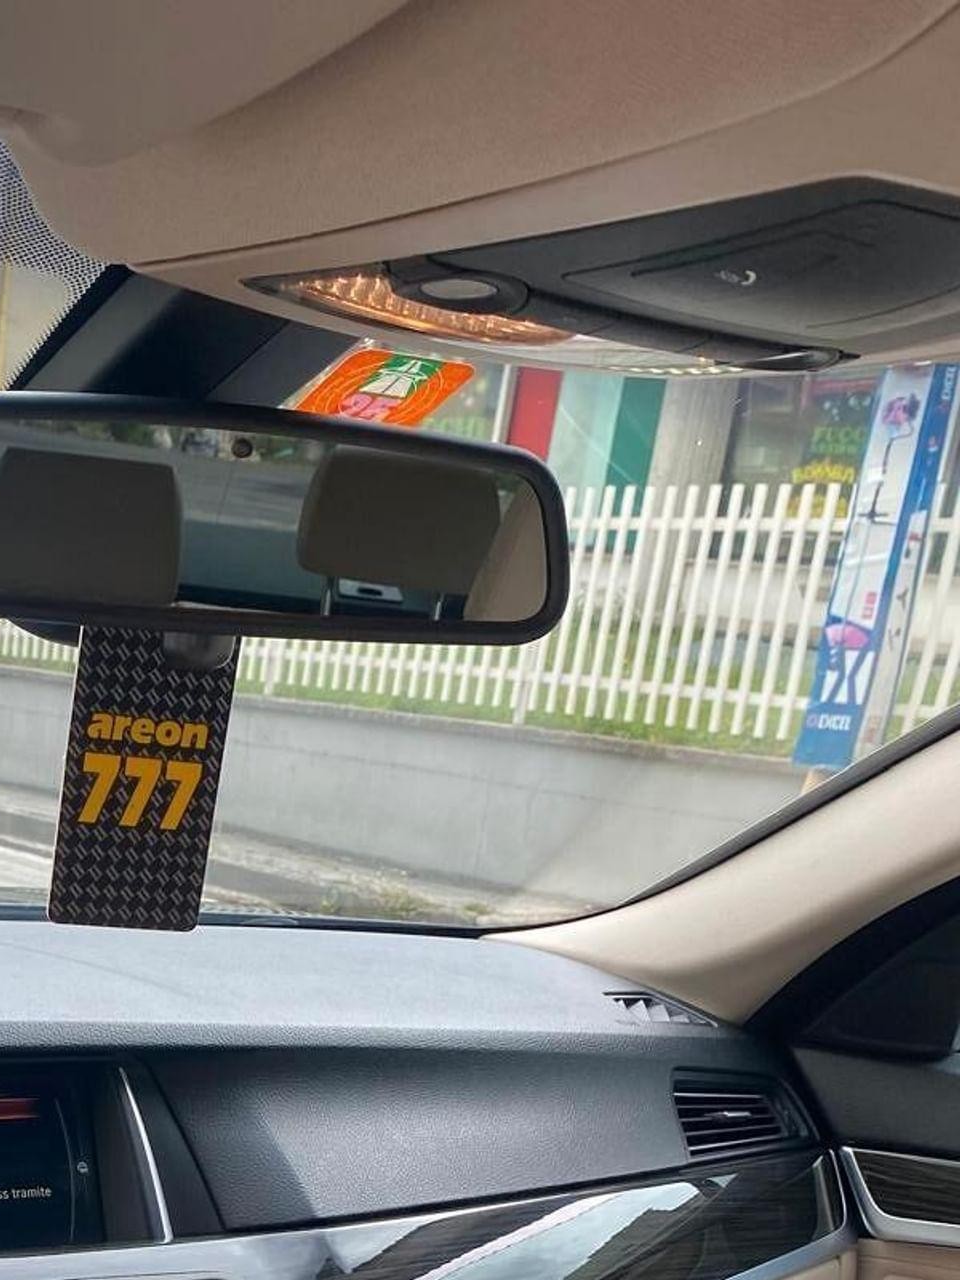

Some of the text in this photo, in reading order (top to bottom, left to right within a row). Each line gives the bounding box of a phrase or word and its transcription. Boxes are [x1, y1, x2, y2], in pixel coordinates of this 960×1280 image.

[86, 711, 210, 750] areon
[77, 751, 203, 832] 777
[11, 1185, 53, 1199] tramite
